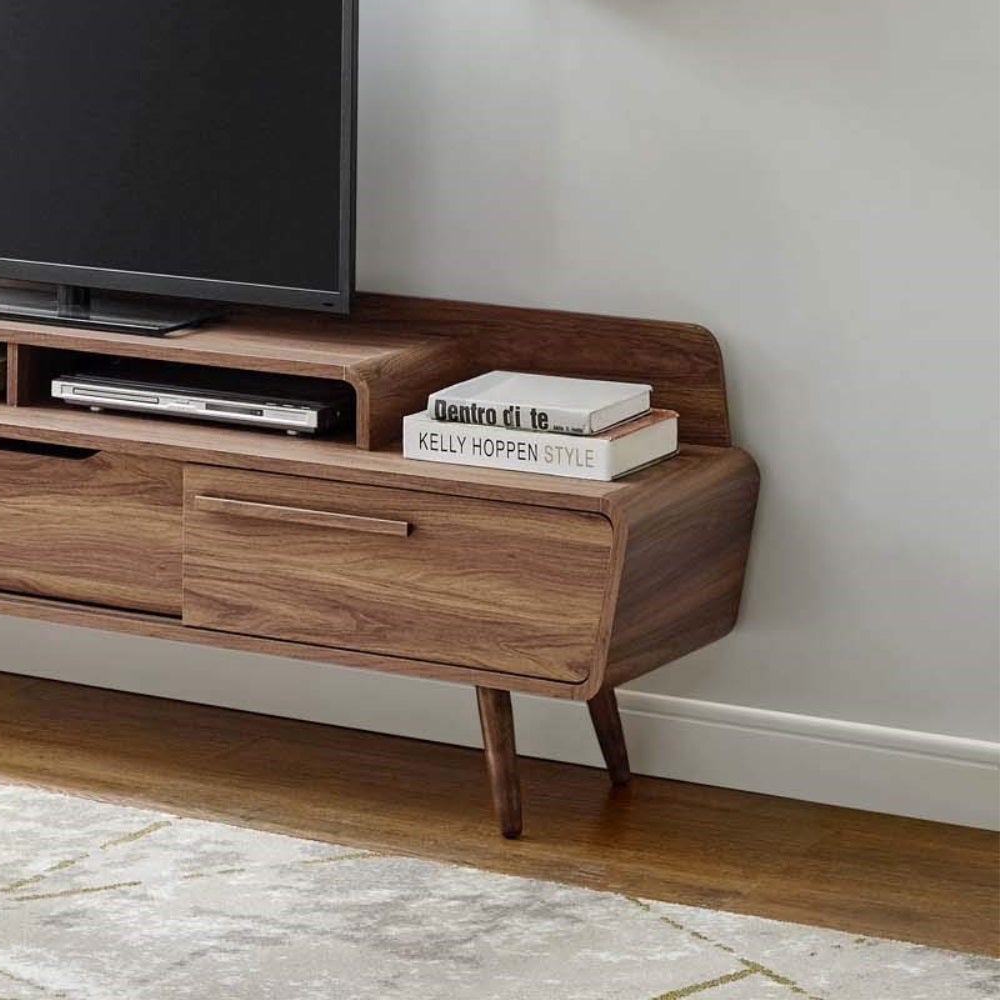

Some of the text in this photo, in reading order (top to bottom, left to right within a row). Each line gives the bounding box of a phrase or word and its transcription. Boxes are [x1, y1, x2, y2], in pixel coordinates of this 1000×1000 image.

[434, 399, 497, 425] Dentro
[503, 405, 521, 427] di
[530, 408, 549, 430] te
[419, 431, 595, 468] KELLY HOPPEN STYLE
